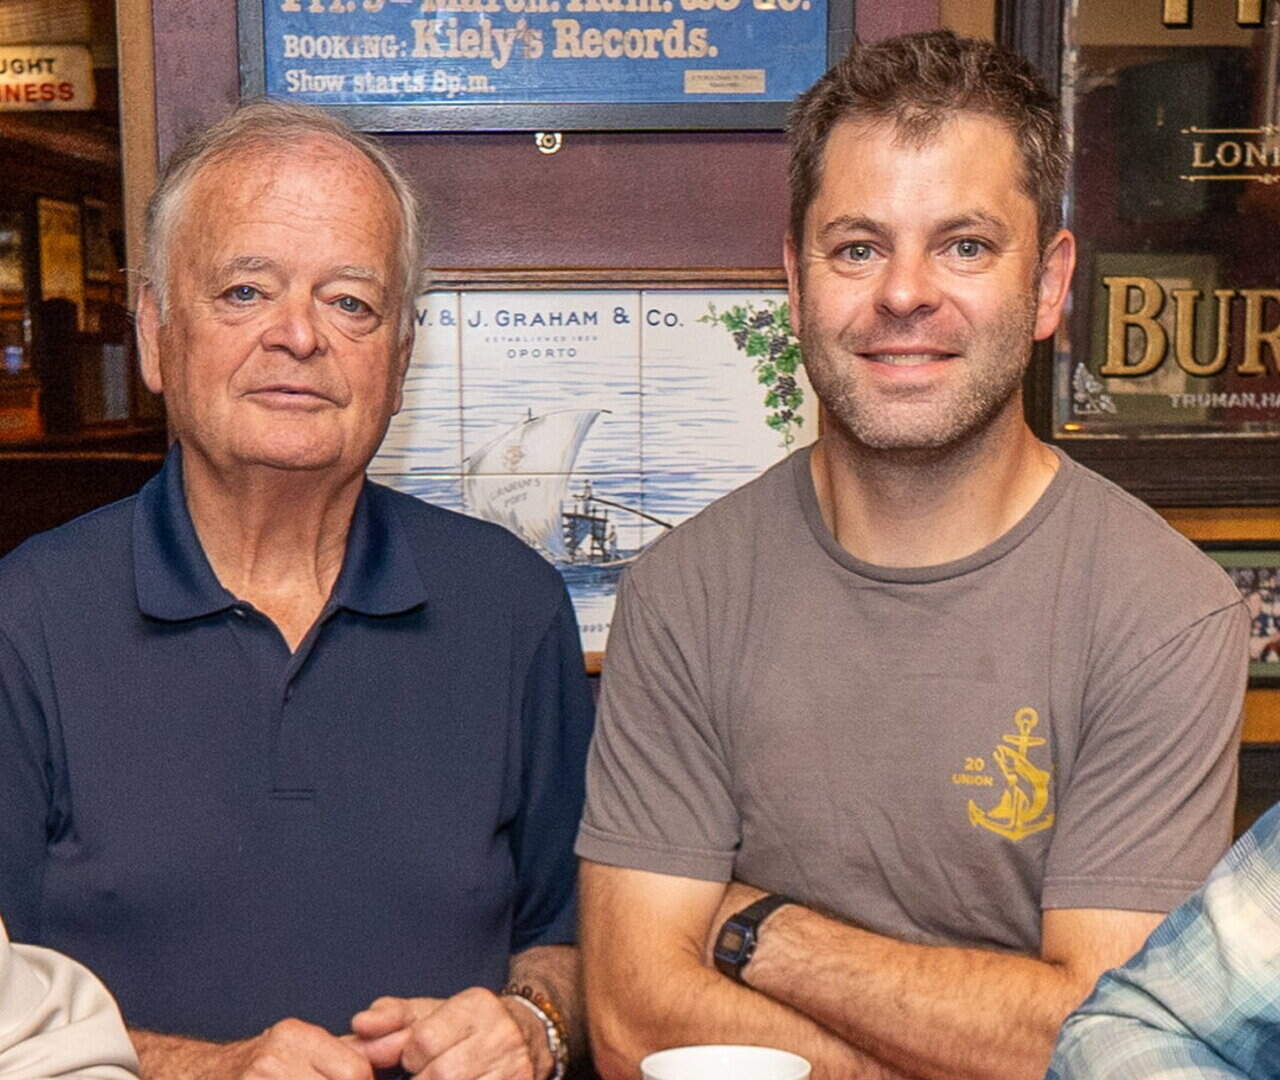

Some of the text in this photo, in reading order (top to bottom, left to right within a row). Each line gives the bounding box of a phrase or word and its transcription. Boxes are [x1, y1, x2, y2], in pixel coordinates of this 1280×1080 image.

[284, 17, 719, 69] BOOKING: Kiely's Records.
[285, 68, 497, 99] Show starts 8p.m.
[439, 309, 456, 327] &
[468, 310, 488, 328] J.
[495, 310, 598, 328] GRAHAM
[613, 307, 631, 325] &
[646, 309, 684, 327] Co.
[506, 348, 577, 359] OPORTO
[964, 757, 985, 771] 20
